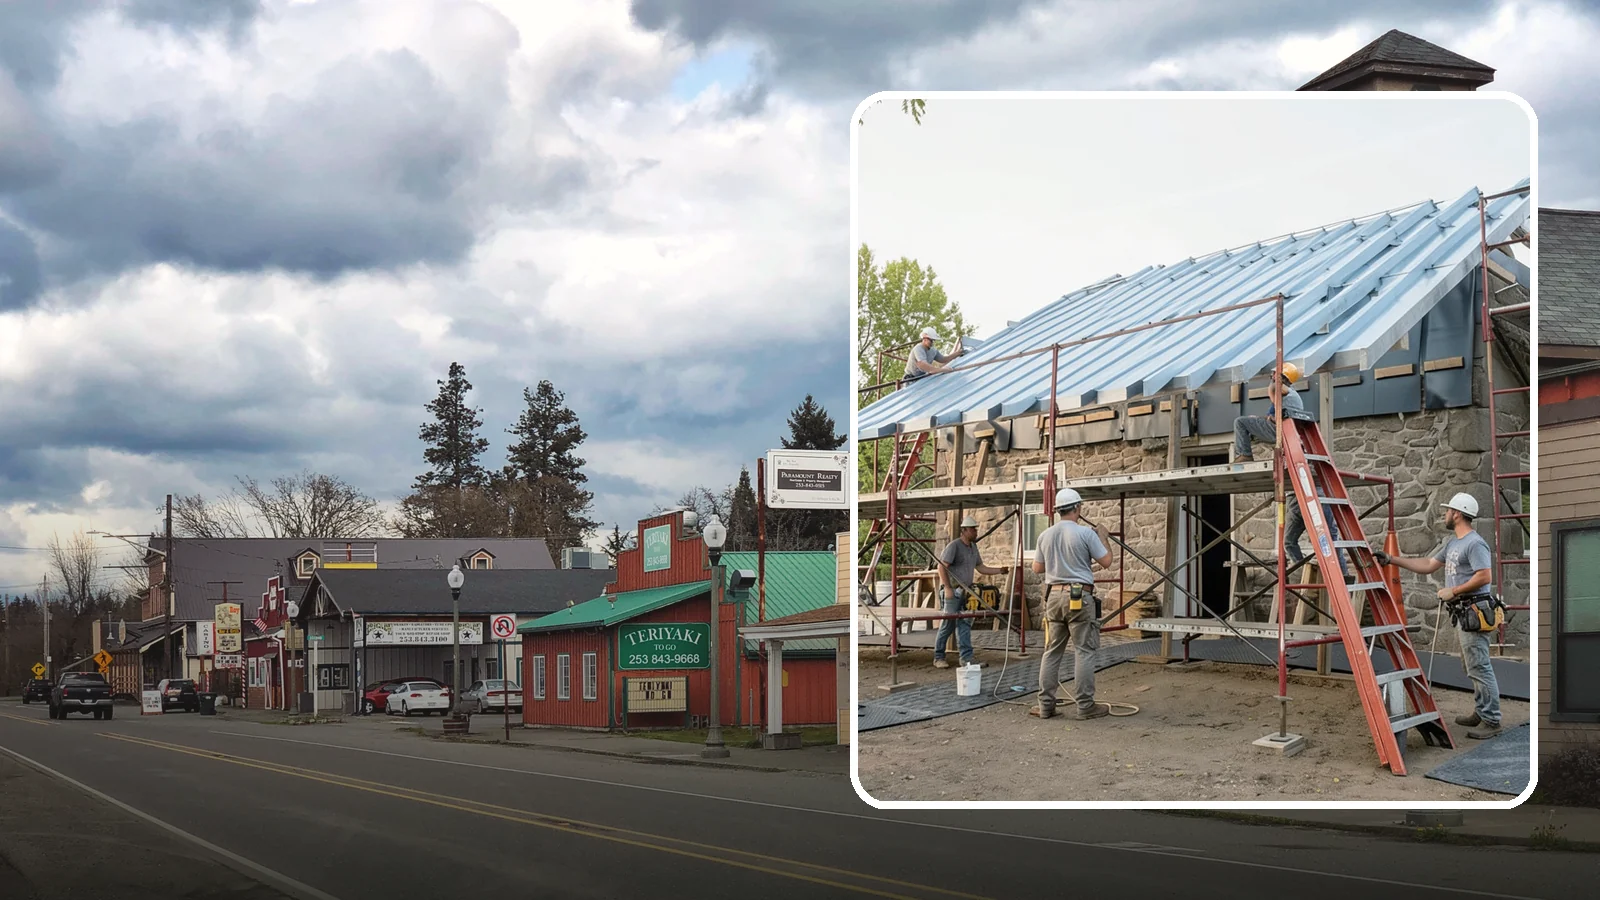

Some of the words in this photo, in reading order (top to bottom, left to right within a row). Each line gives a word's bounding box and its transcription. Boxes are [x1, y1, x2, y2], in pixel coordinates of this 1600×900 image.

[781, 471, 814, 479] PARAMOUNT
[817, 472, 839, 480] REALTY
[624, 627, 702, 646] TERIYAKI
[629, 654, 649, 664] 253
[651, 654, 700, 664] 843-9668
[639, 681, 673, 691] TERIYAKI
